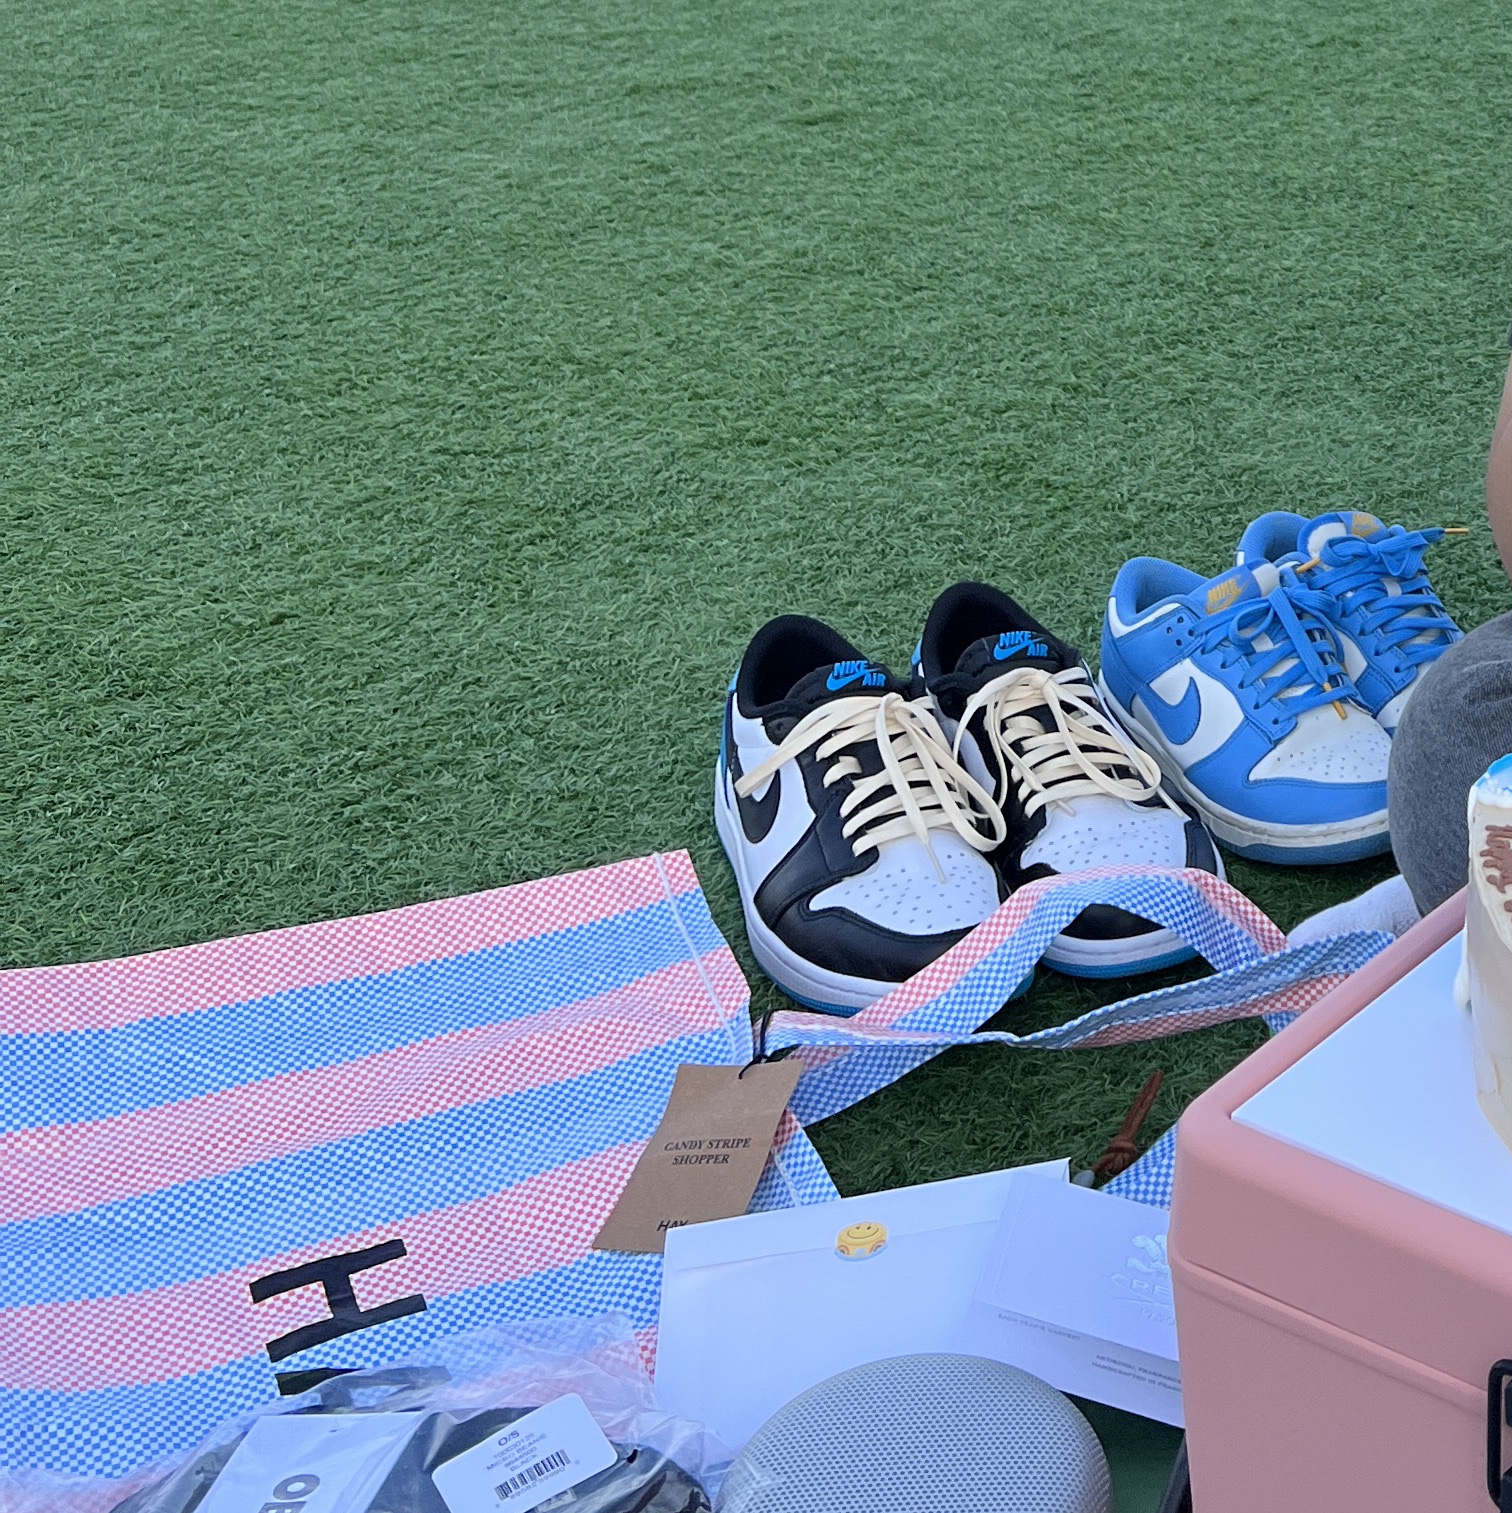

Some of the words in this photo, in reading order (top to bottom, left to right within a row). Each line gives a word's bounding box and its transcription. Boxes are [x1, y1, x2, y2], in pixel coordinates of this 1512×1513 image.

[999, 630, 1033, 649] NIKE
[1026, 642, 1049, 657] AIR
[833, 660, 869, 678] NIKE
[862, 672, 888, 687] AIR
[663, 1139, 705, 1151] CANDY
[706, 1137, 752, 1149] STRIPE
[672, 1153, 730, 1165] SHOPPER
[497, 1429, 520, 1446] O/S
